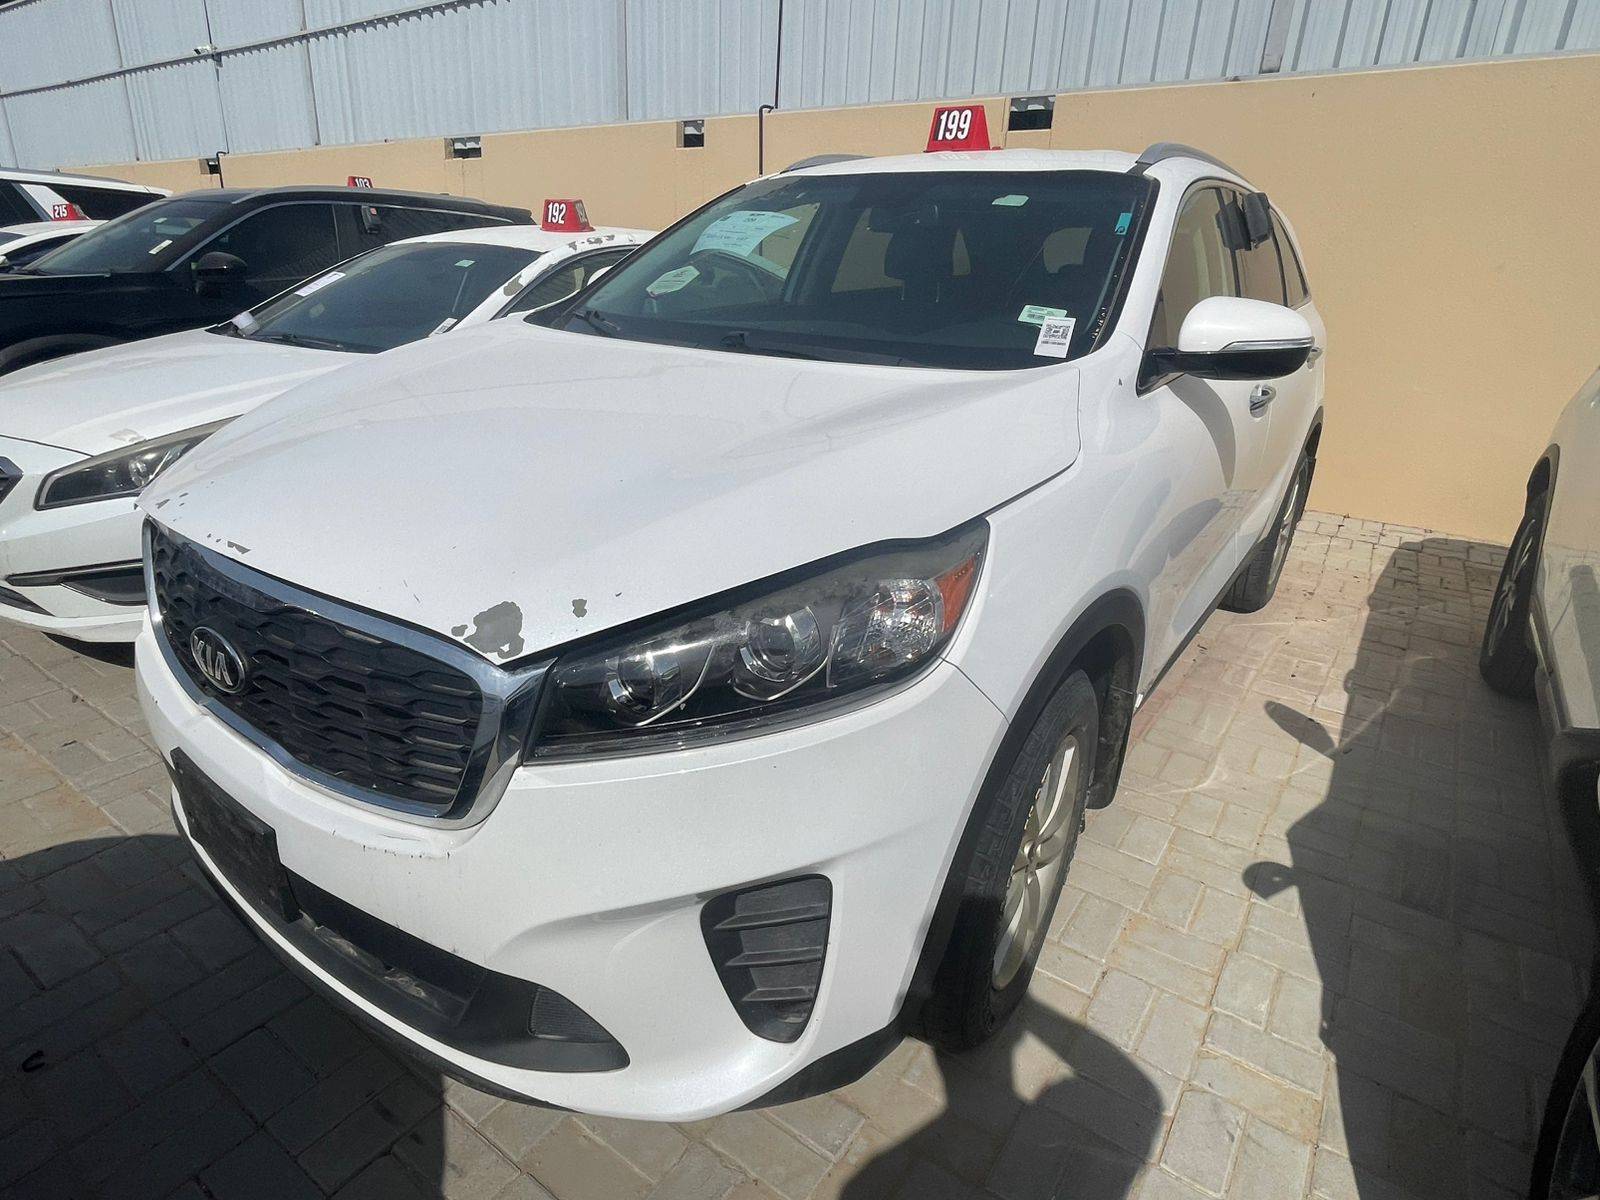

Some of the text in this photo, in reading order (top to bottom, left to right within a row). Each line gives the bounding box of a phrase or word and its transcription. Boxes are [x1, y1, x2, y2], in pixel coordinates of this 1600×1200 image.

[937, 109, 972, 141] 199
[54, 205, 68, 218] 215
[547, 202, 566, 224] 192
[193, 635, 234, 687] KIA
